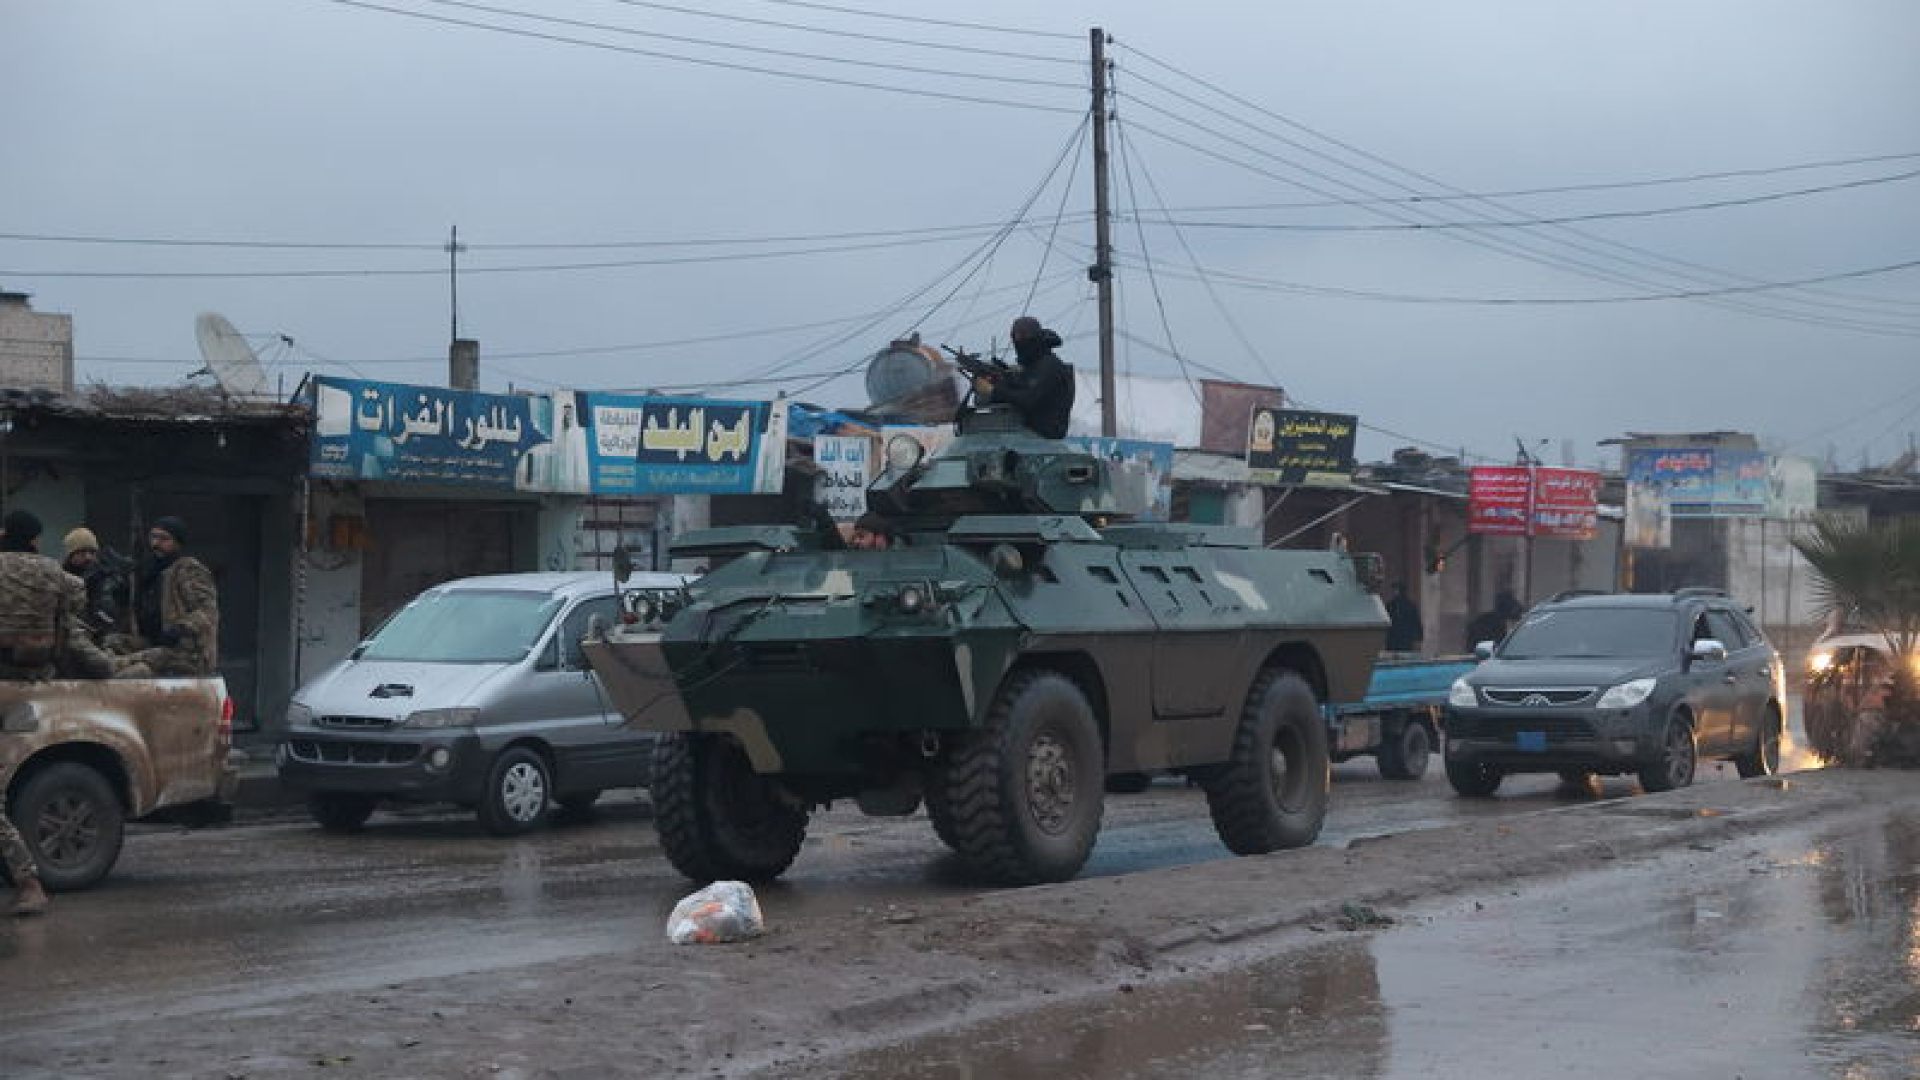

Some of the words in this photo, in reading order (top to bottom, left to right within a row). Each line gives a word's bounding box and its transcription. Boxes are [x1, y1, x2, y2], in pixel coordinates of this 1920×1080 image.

[357, 388, 455, 444] الفرات
[456, 405, 522, 456] بللور
[643, 407, 704, 461] البلد
[707, 409, 750, 461] ابن
